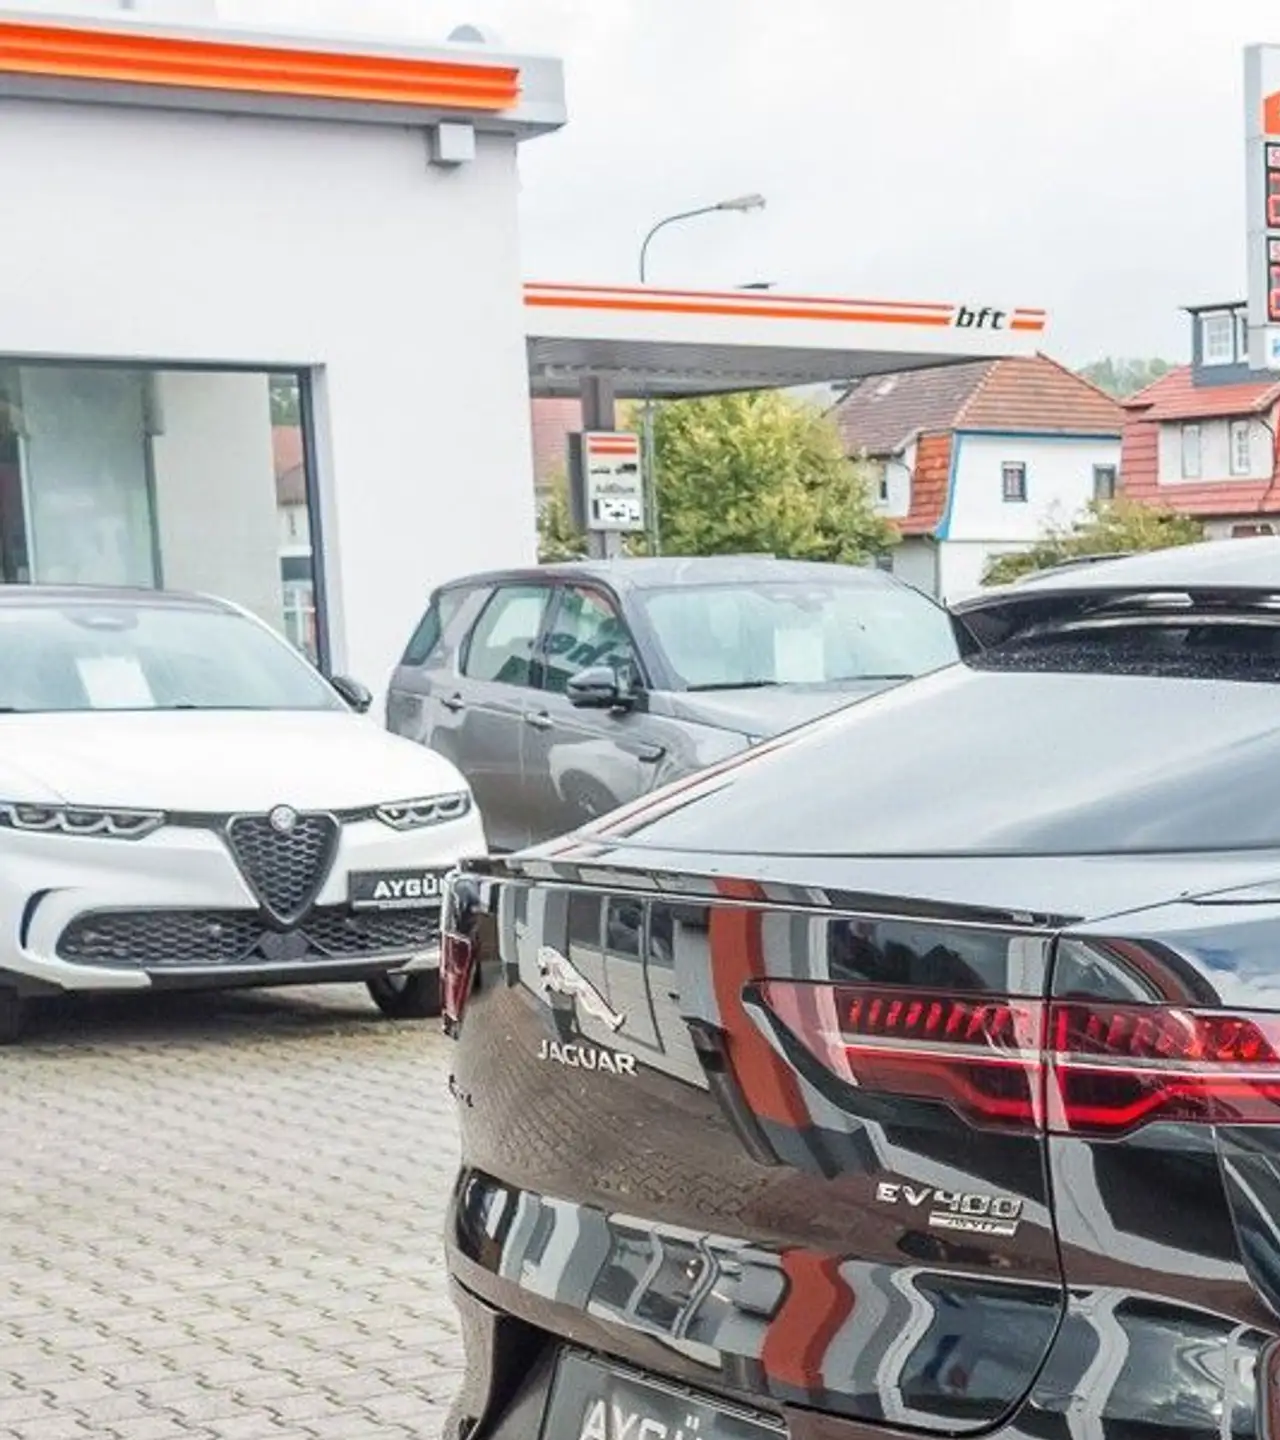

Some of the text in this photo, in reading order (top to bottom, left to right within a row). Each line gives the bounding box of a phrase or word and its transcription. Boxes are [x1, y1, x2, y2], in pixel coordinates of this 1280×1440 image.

[956, 306, 1006, 330] bft
[373, 873, 446, 898] AYGÜ
[537, 1039, 638, 1077] JAGUAR
[875, 1182, 1023, 1217] EV400
